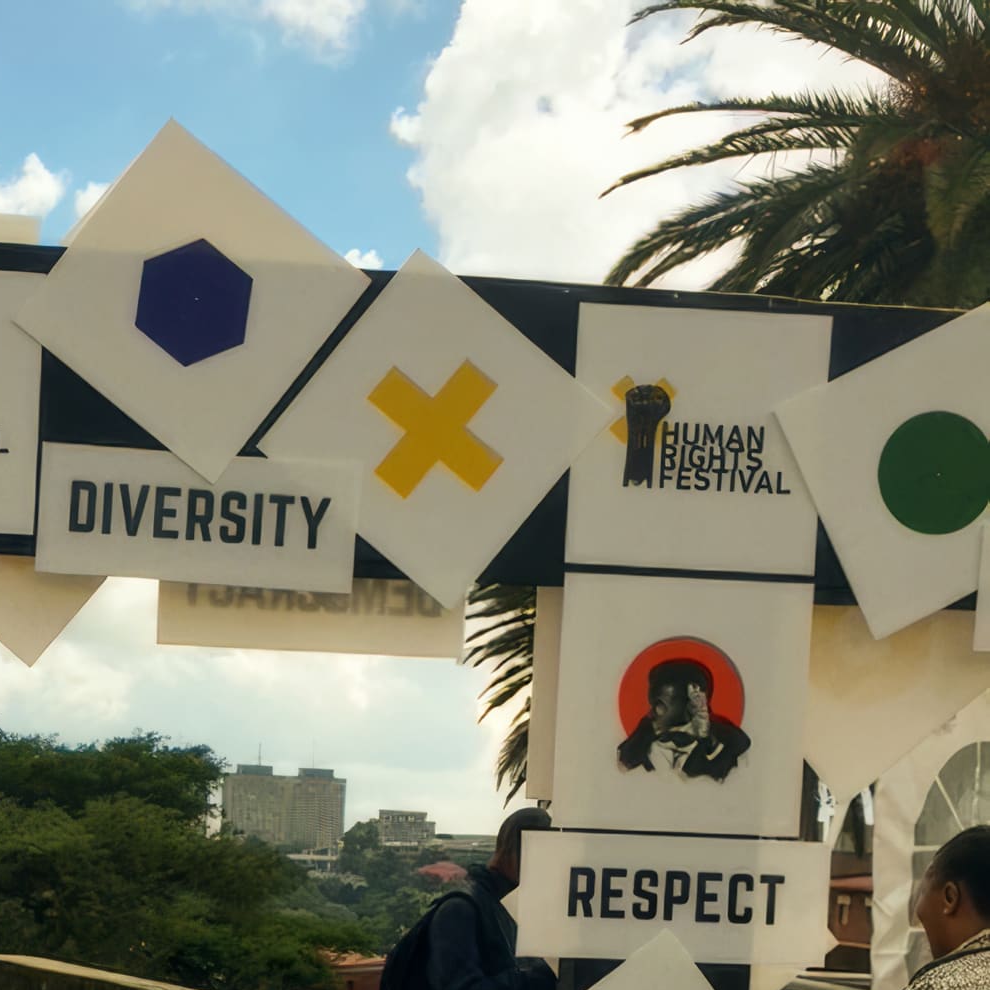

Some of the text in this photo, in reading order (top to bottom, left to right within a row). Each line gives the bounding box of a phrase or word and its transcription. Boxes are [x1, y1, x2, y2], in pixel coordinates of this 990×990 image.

[662, 421, 764, 452] HUMAN
[660, 444, 763, 474] RIGHTS
[659, 466, 791, 494] FESTIVAL
[69, 481, 330, 549] DIVERSITY
[568, 867, 784, 925] RESPECT
